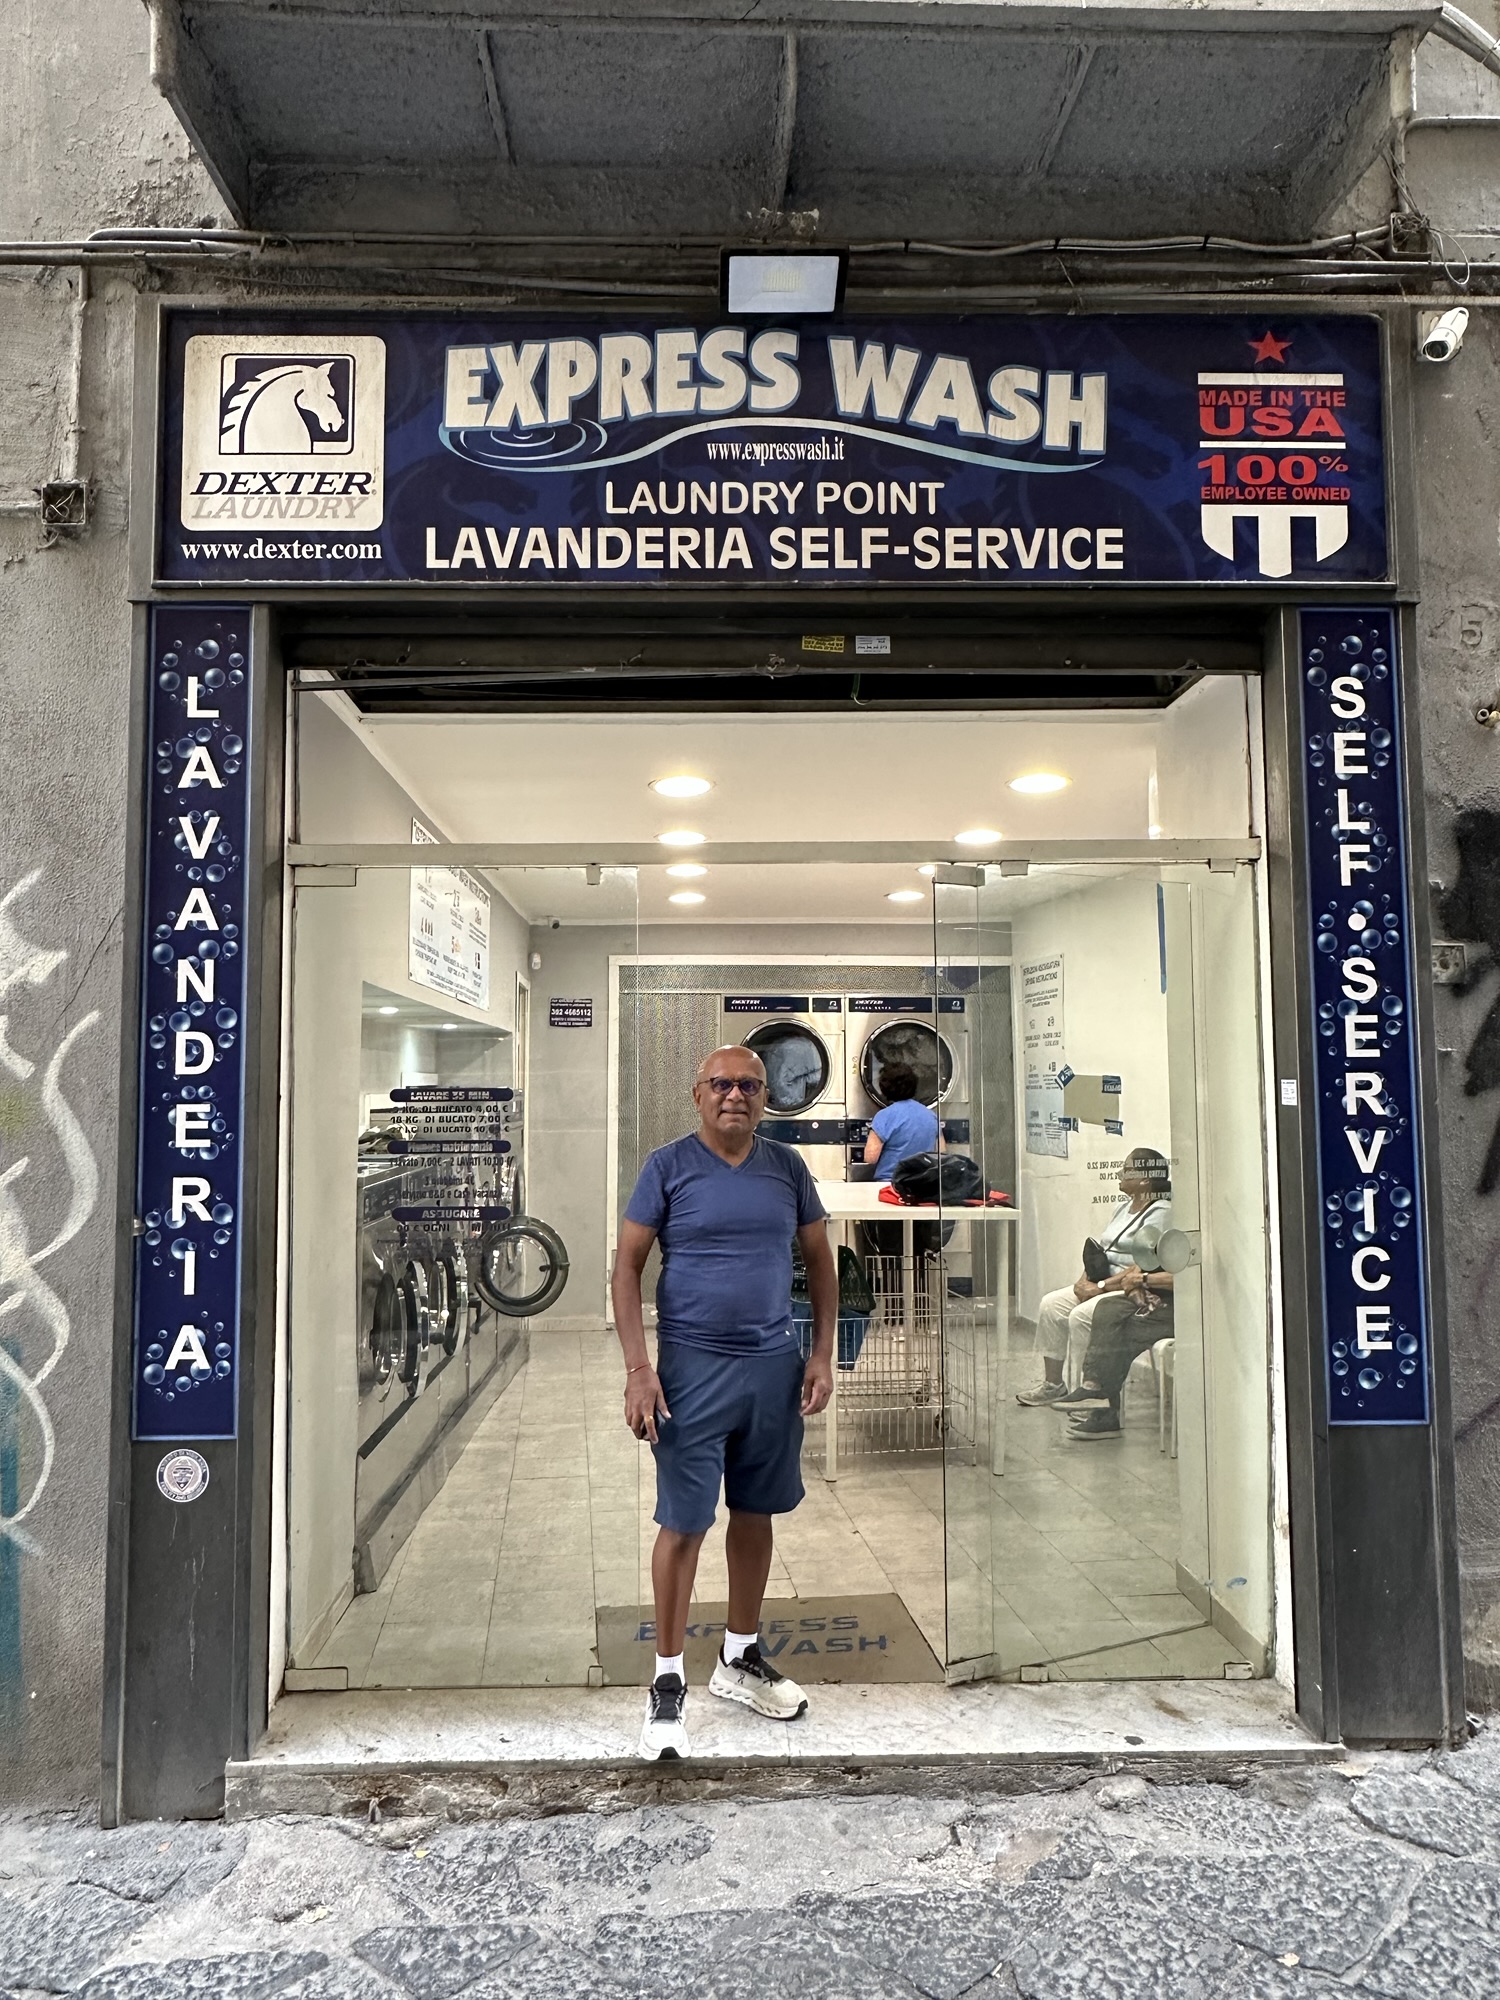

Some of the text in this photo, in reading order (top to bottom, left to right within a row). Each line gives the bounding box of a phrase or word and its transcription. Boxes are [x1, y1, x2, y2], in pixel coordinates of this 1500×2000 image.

[444, 326, 1107, 455] EXPRESS WASH
[1200, 390, 1346, 407] MADE IN THE
[1200, 407, 1345, 437] USA
[707, 436, 845, 466] www.expresswash.it
[1198, 454, 1349, 485] 100%
[605, 482, 945, 515] LAUNDRY POINT
[1201, 487, 1350, 500] EMPLOYEE OWNED
[191, 496, 369, 519] LAUNDRY
[181, 538, 382, 560] www.dexter.com
[426, 527, 1124, 570] LAVANDERIA SELF-SERVICE
[164, 676, 223, 1370] LAVANDERIA
[410, 1091, 449, 1100] LAVARE
[422, 1105, 431, 1113] DI
[436, 1105, 472, 1113] BUCATO
[439, 1115, 475, 1123] BUCATO
[479, 1115, 500, 1124] 7,00
[504, 1125, 511, 1133] €
[422, 1209, 480, 1219] ASCIUGARE
[423, 1223, 450, 1232] OGNI
[633, 1615, 859, 1641] EXPESS
